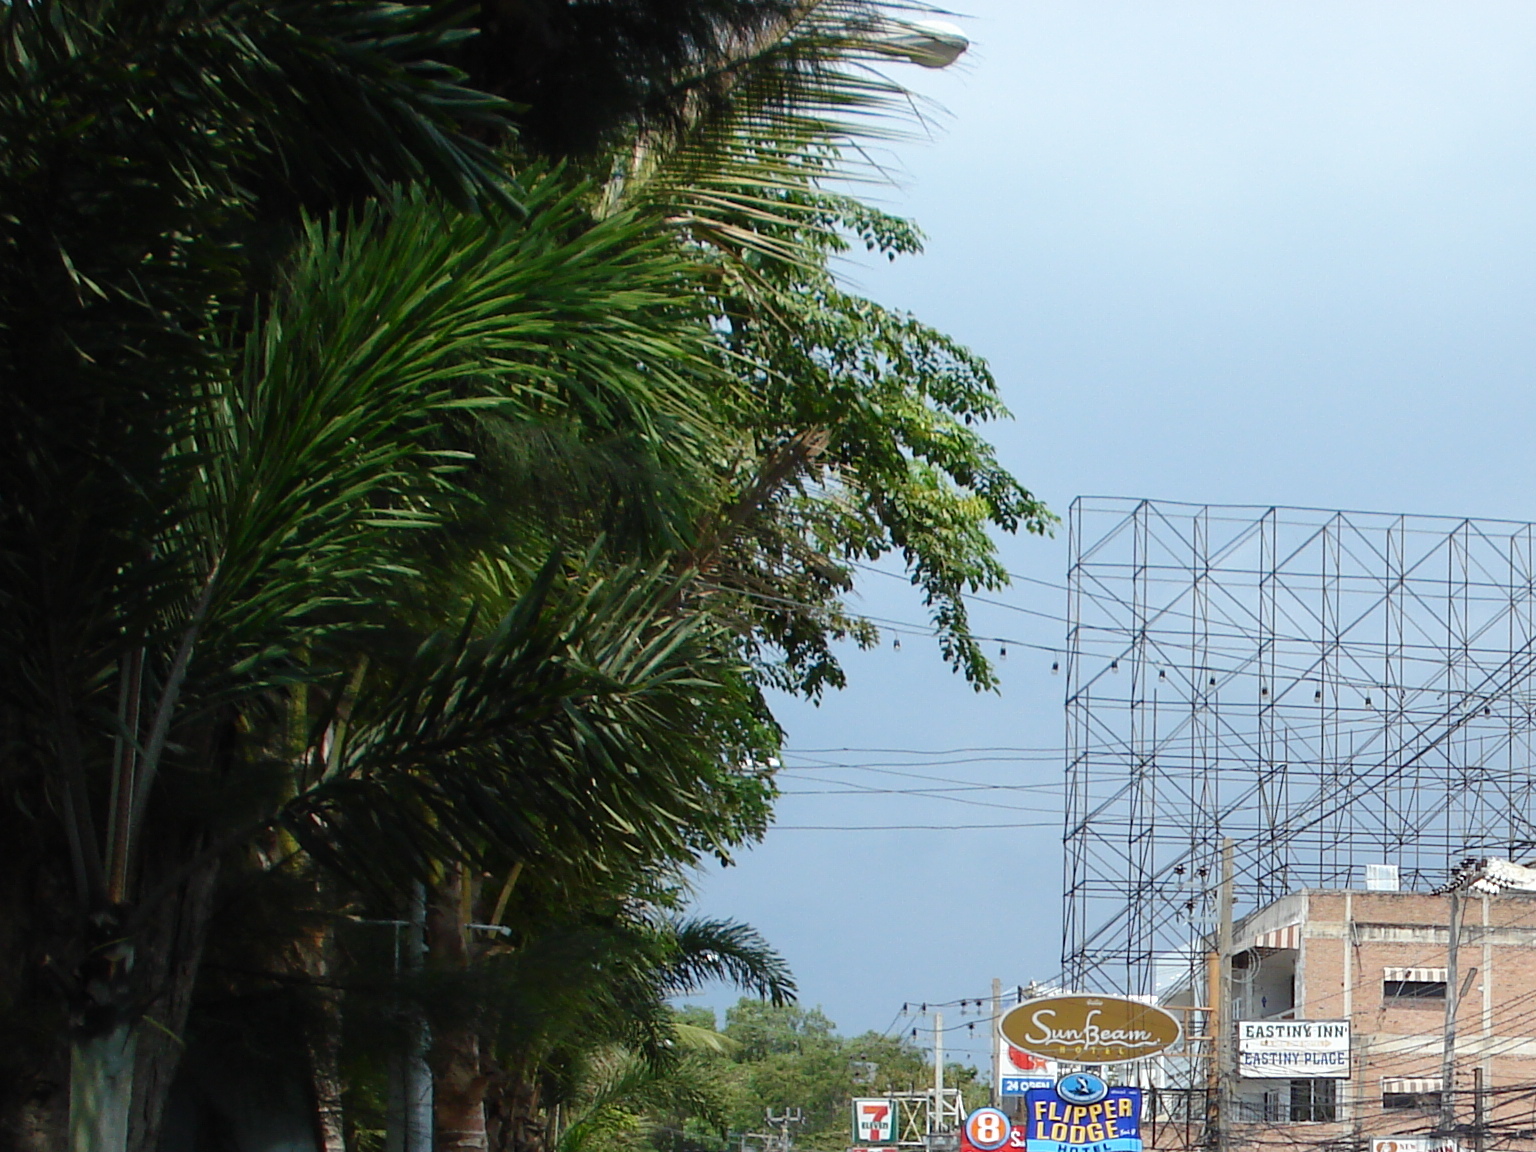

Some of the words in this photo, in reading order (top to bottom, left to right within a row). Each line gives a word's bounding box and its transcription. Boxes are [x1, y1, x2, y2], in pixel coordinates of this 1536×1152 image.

[1246, 1025, 1312, 1038] EASTINY
[1318, 1025, 1344, 1038] INN
[1060, 1046, 1125, 1054] HOTEL
[1245, 1052, 1299, 1065] EASTINY
[1304, 1052, 1345, 1065] PLACE
[1006, 1080, 1019, 1092] 24
[1034, 1098, 1133, 1125] FLIPPER
[977, 1113, 999, 1143] 8
[1036, 1119, 1119, 1144] LODGE
